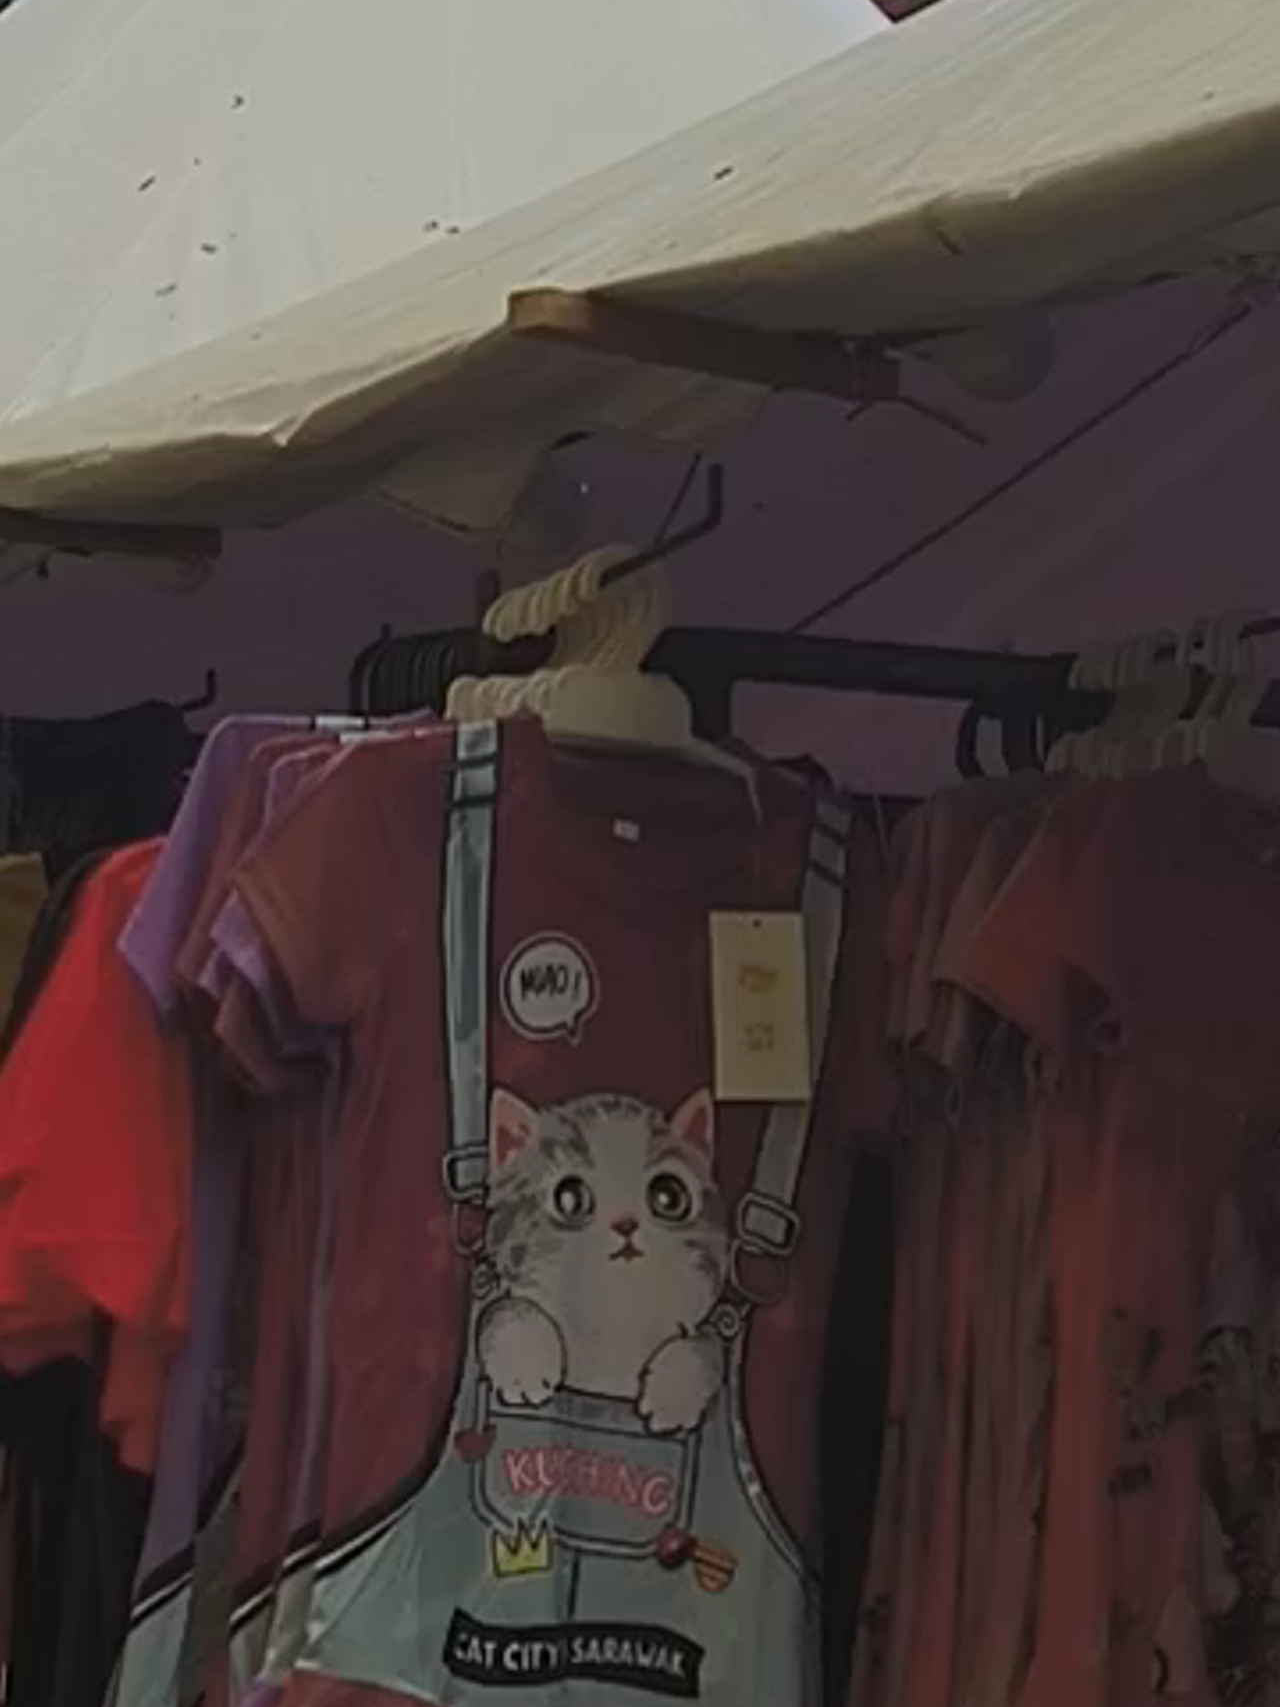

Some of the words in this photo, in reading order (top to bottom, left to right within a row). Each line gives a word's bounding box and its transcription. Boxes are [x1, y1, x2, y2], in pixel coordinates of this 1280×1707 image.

[454, 1633, 496, 1670] CAT
[502, 1639, 559, 1672] CITY
[570, 1636, 687, 1677] SARAWAK
